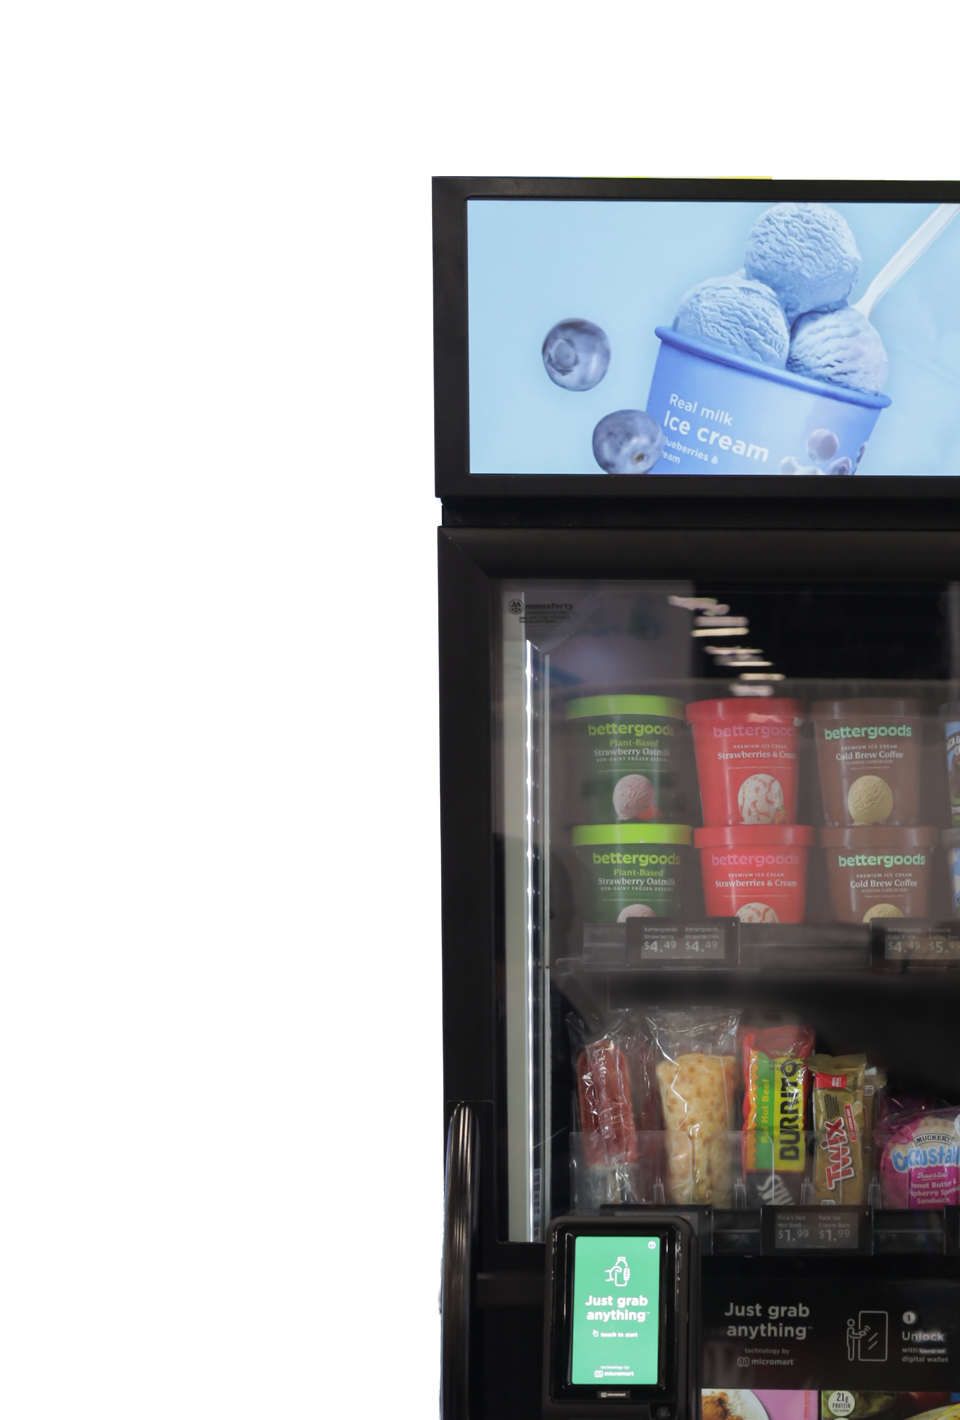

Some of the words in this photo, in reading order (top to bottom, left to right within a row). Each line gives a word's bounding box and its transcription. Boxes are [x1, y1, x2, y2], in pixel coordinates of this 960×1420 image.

[669, 393, 698, 414] Real
[700, 407, 734, 427] milk
[663, 410, 691, 435] Ice
[697, 426, 770, 462] cream
[588, 722, 675, 737] bettergoods
[824, 724, 912, 740] bettergoods
[609, 739, 659, 747] Plant-Based
[835, 752, 853, 761] Cold
[855, 751, 877, 760] Brew
[878, 751, 904, 759] Coffee
[593, 852, 681, 867] bettergoods
[711, 854, 799, 868] bettergoods
[838, 854, 926, 868] bettergoods
[613, 868, 664, 877] Plant-Based
[715, 879, 765, 888] Strawberries
[774, 879, 797, 887] Cream
[850, 880, 868, 888] Cold
[870, 880, 892, 888] Brew
[893, 879, 918, 887] Coffee
[644, 940, 677, 953] $4.49
[685, 940, 718, 953] $4.49
[888, 941, 921, 953] $4.49
[779, 1060, 801, 1161] BURRITO
[916, 1196, 950, 1204] Sandwich
[778, 1229, 809, 1242] $1.99
[819, 1229, 850, 1242] $1.99
[585, 1294, 614, 1306] Just
[617, 1294, 649, 1308] grab
[586, 1309, 646, 1323] anything
[724, 1302, 762, 1317] Just
[768, 1302, 810, 1320] grab
[727, 1322, 807, 1340] anything
[901, 1331, 945, 1342] Unlock
[744, 1347, 780, 1355] technology
[751, 1358, 794, 1366] micromart
[901, 1355, 925, 1363] digital
